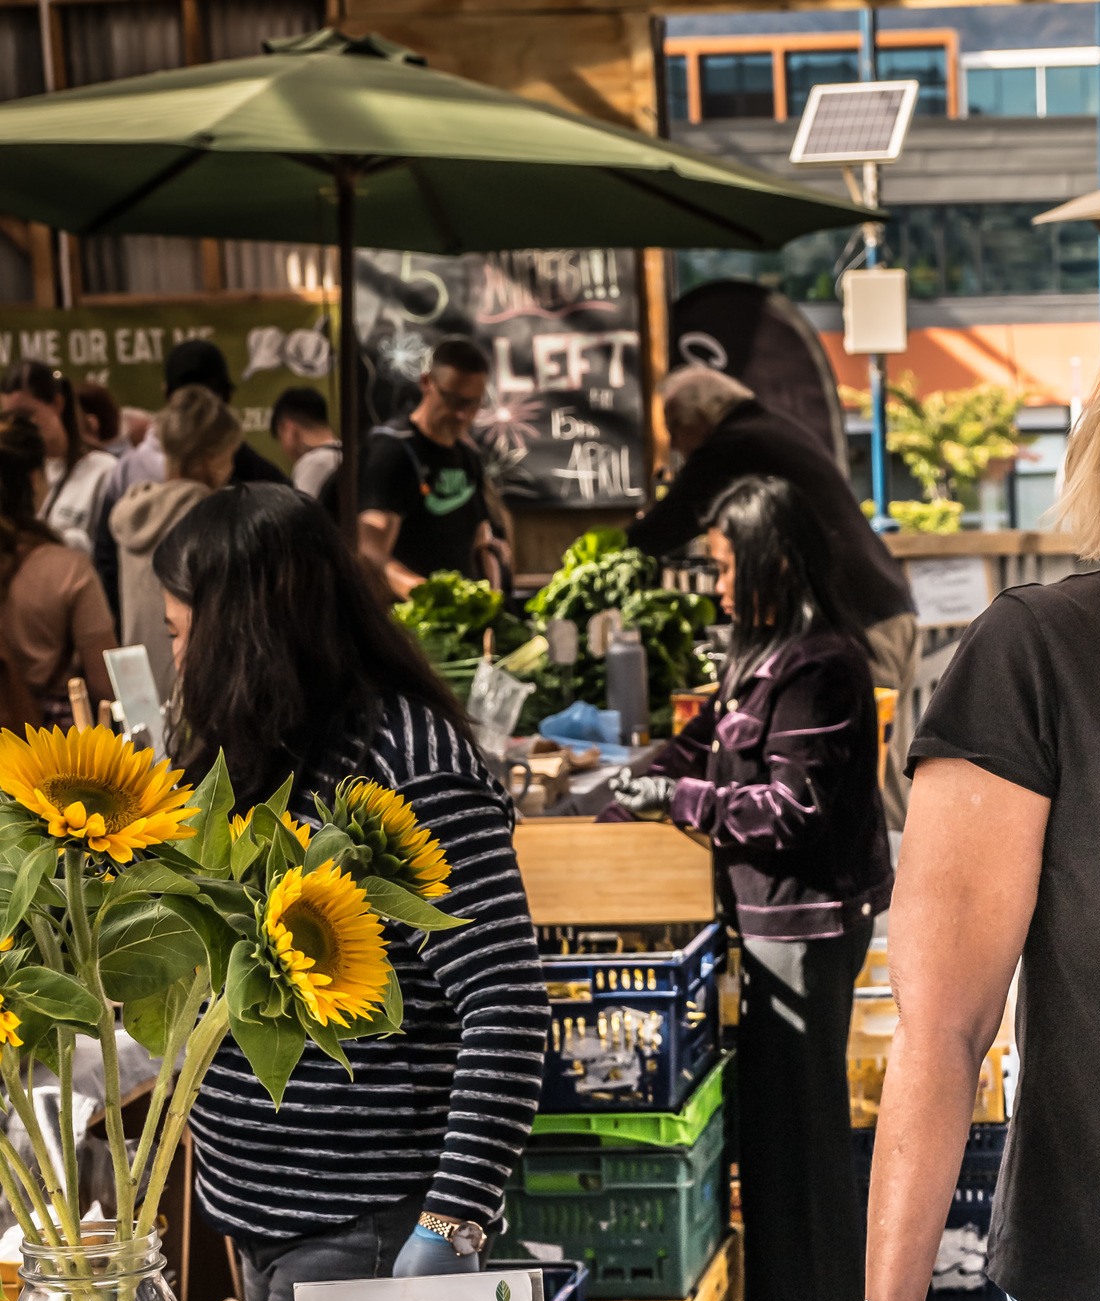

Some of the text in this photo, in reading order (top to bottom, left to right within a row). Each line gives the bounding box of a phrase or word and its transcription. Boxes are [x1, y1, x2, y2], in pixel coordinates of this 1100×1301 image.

[19, 329, 61, 365] ME
[69, 328, 108, 365] OR
[115, 328, 166, 365] EAT
[494, 330, 640, 393] LEFT
